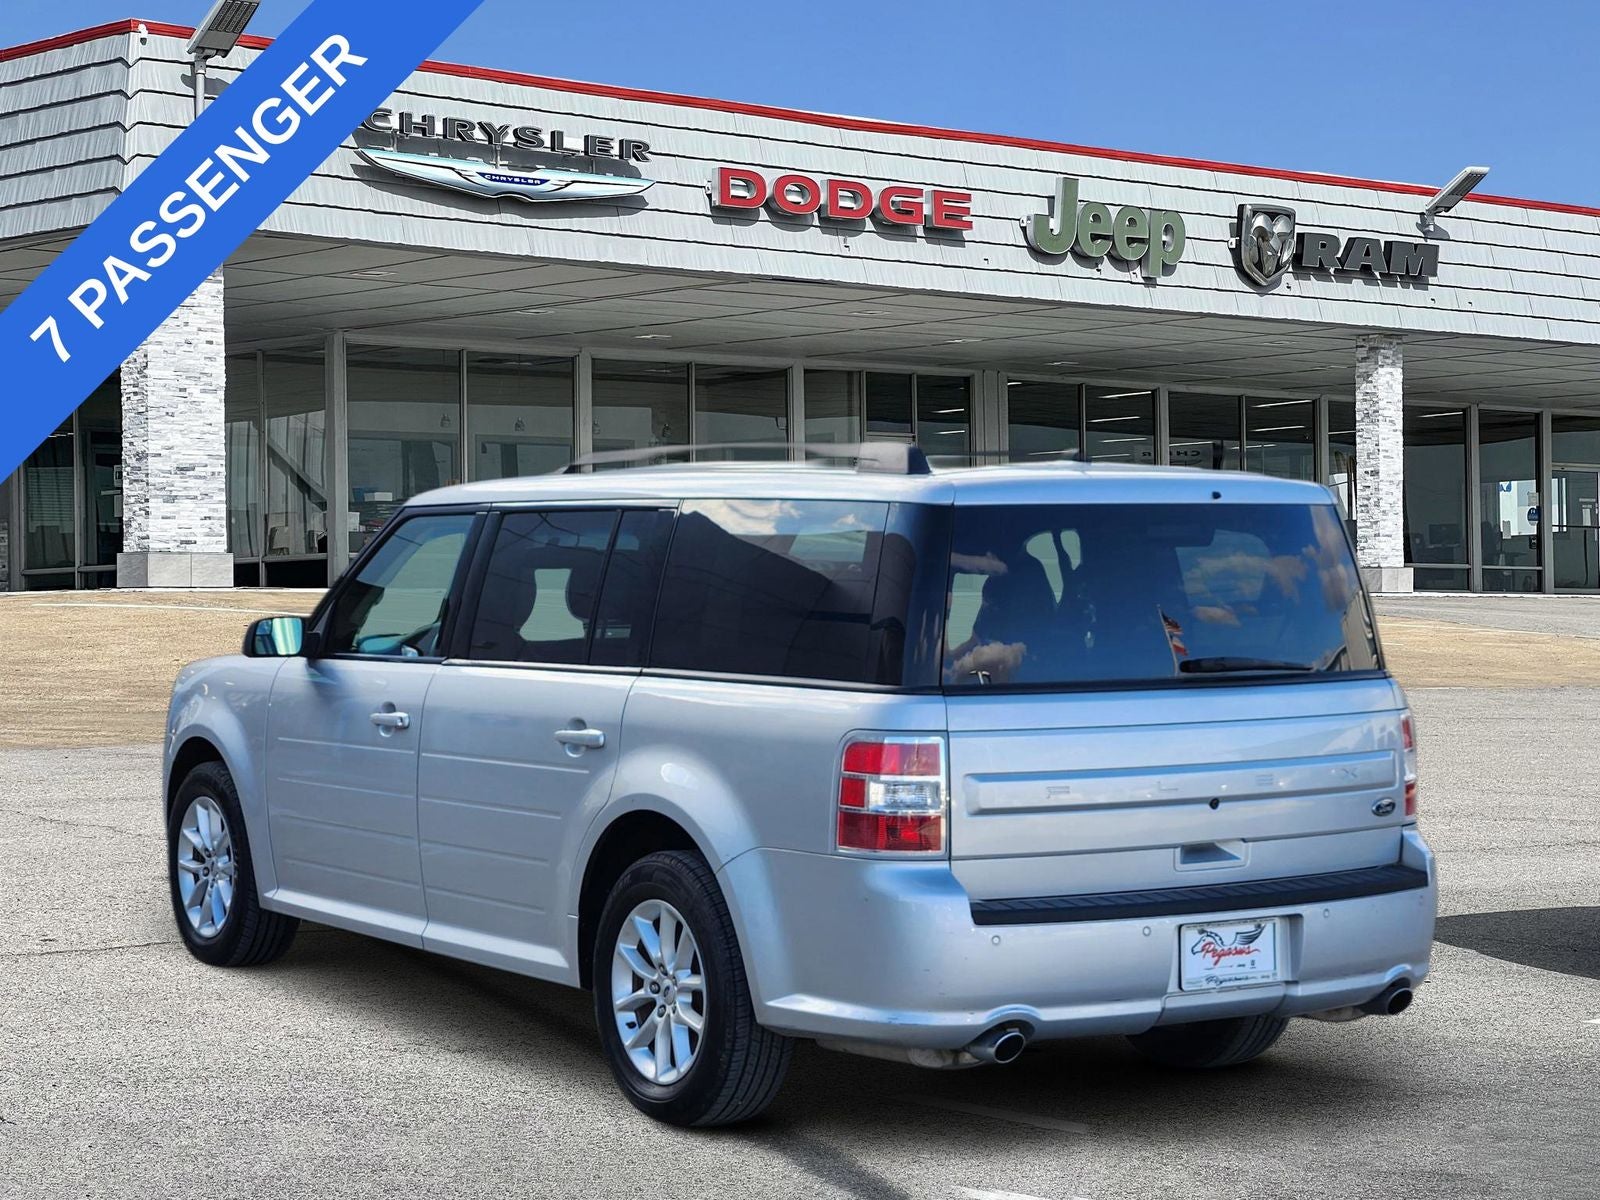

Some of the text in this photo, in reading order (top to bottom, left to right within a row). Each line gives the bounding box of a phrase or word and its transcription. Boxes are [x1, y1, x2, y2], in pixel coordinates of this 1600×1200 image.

[361, 107, 651, 162] CHRYSLER
[484, 174, 541, 185] CHRYSLER
[711, 166, 974, 231] DODGE
[1026, 176, 1186, 278] Jeep
[1294, 231, 1440, 277] RAM
